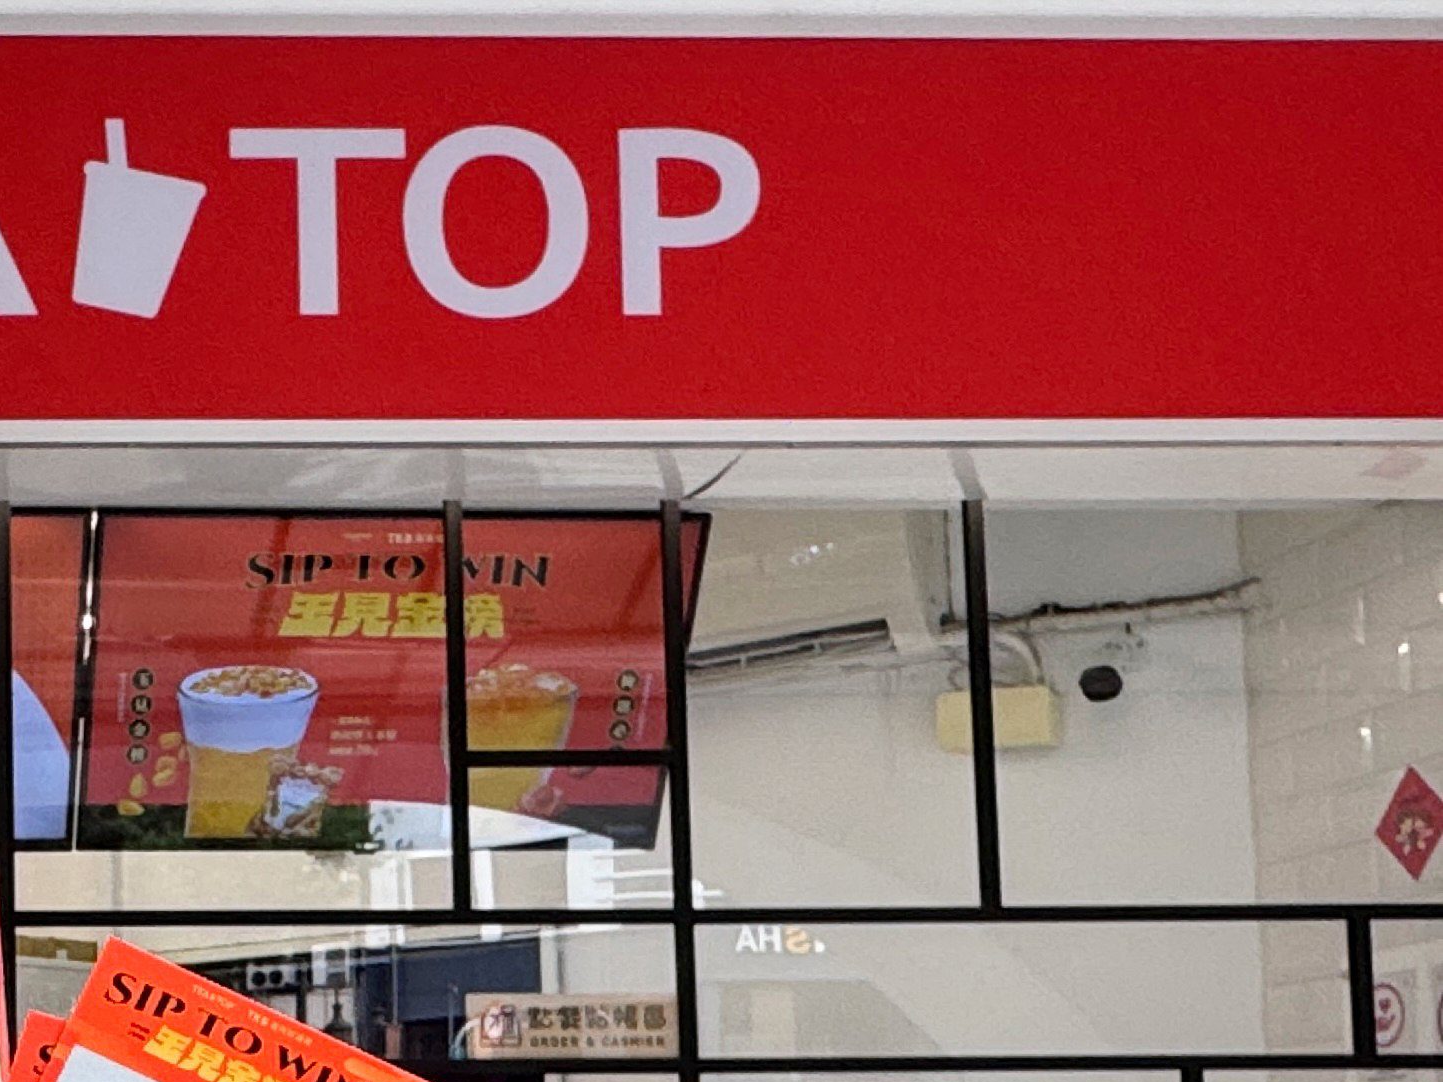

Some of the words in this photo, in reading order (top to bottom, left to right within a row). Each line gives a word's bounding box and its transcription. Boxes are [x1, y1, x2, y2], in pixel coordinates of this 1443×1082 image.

[229, 125, 762, 318] TOP
[245, 552, 334, 589] SIP
[346, 553, 427, 581] TO
[103, 971, 186, 1018] SIP
[197, 1007, 263, 1055] TO
[529, 1035, 579, 1048] ORDER
[585, 1035, 595, 1048] &
[601, 1035, 666, 1048] CASHIER
